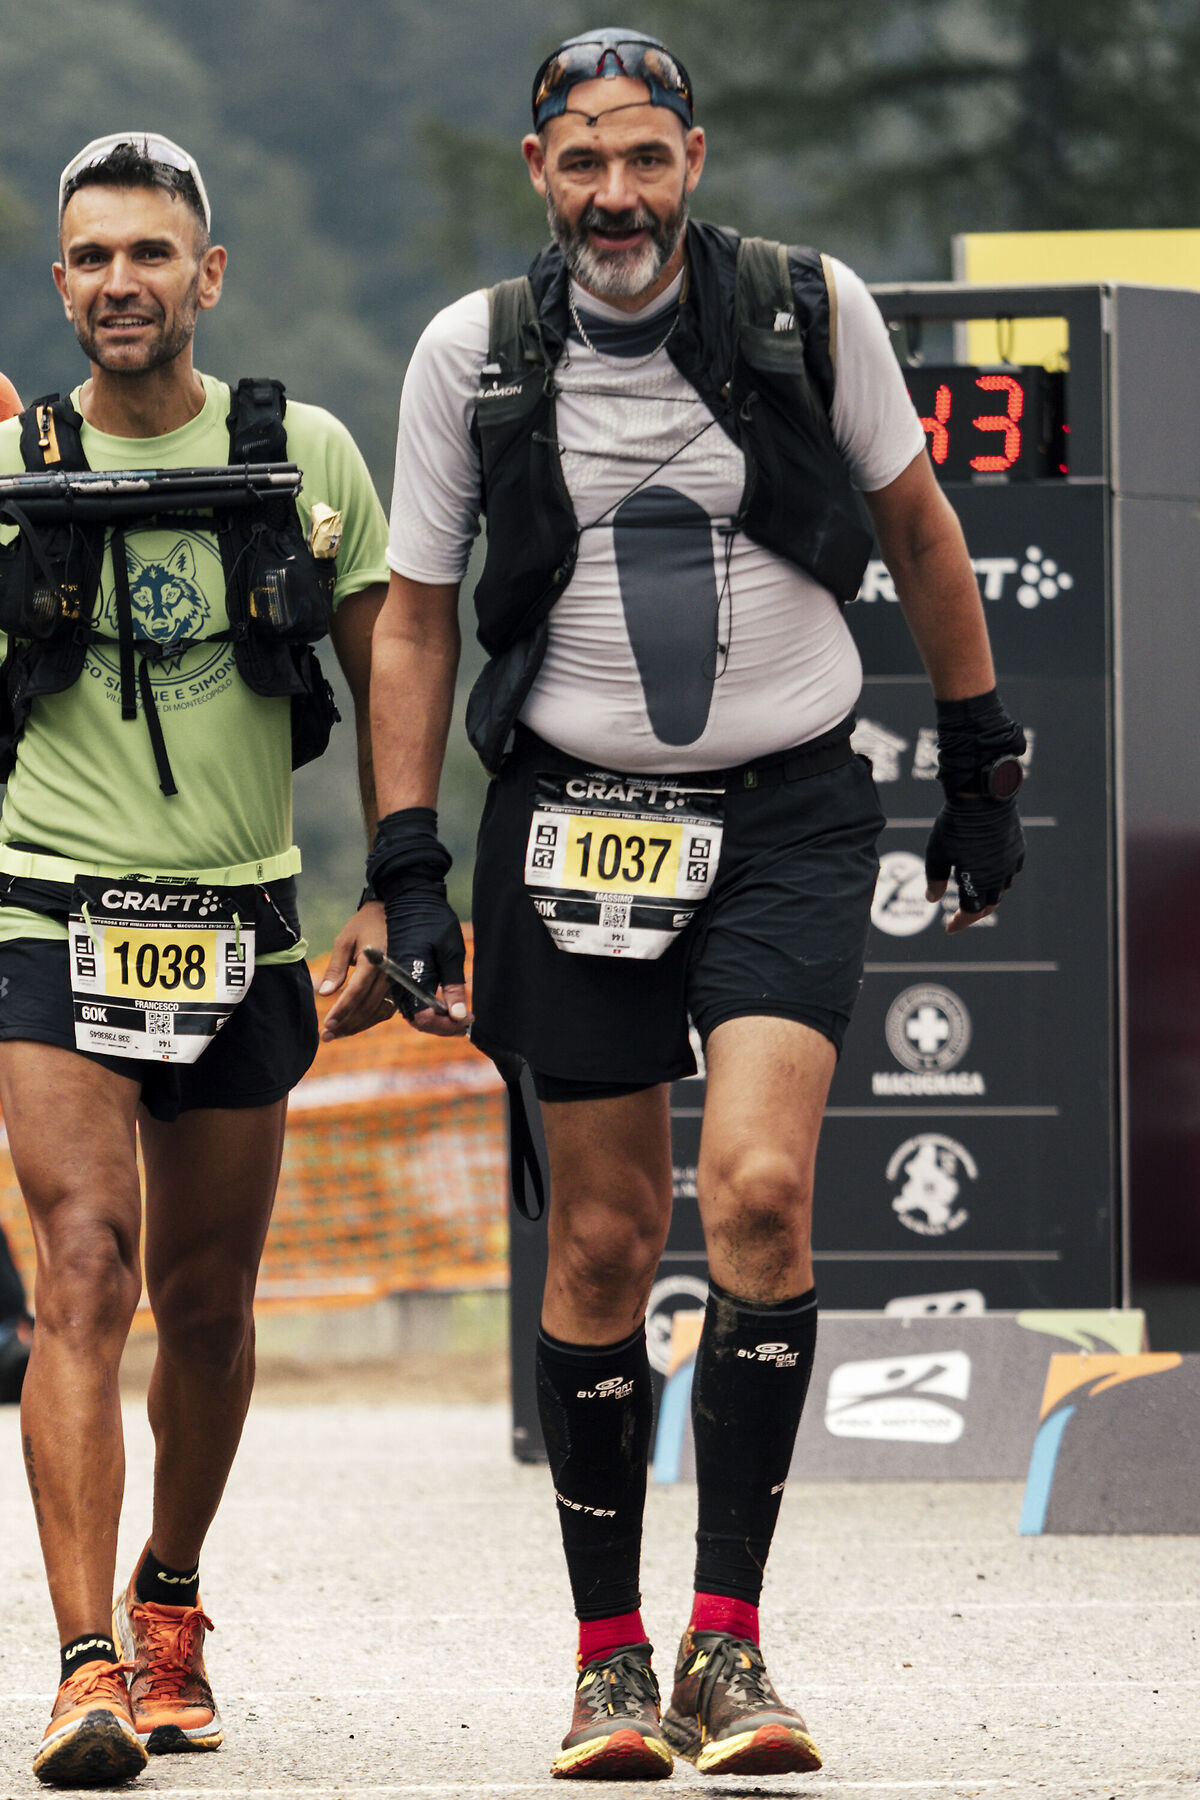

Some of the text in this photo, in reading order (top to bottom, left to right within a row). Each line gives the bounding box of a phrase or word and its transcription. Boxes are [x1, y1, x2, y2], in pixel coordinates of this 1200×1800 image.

[175, 688, 185, 700] E
[565, 778, 664, 805] CRAFT
[576, 831, 672, 884] 1037
[101, 889, 200, 912] CRAFT
[595, 892, 634, 904] MASSIMO
[113, 941, 206, 991] 1038
[81, 1005, 108, 1023] 60K
[134, 999, 180, 1012] FRANCESCO
[158, 1039, 172, 1048] 144
[737, 1348, 800, 1362] BV SPORT
[576, 1390, 597, 1399] BV
[598, 1379, 635, 1399] SPORT
[555, 1490, 617, 1518] OOSTER
